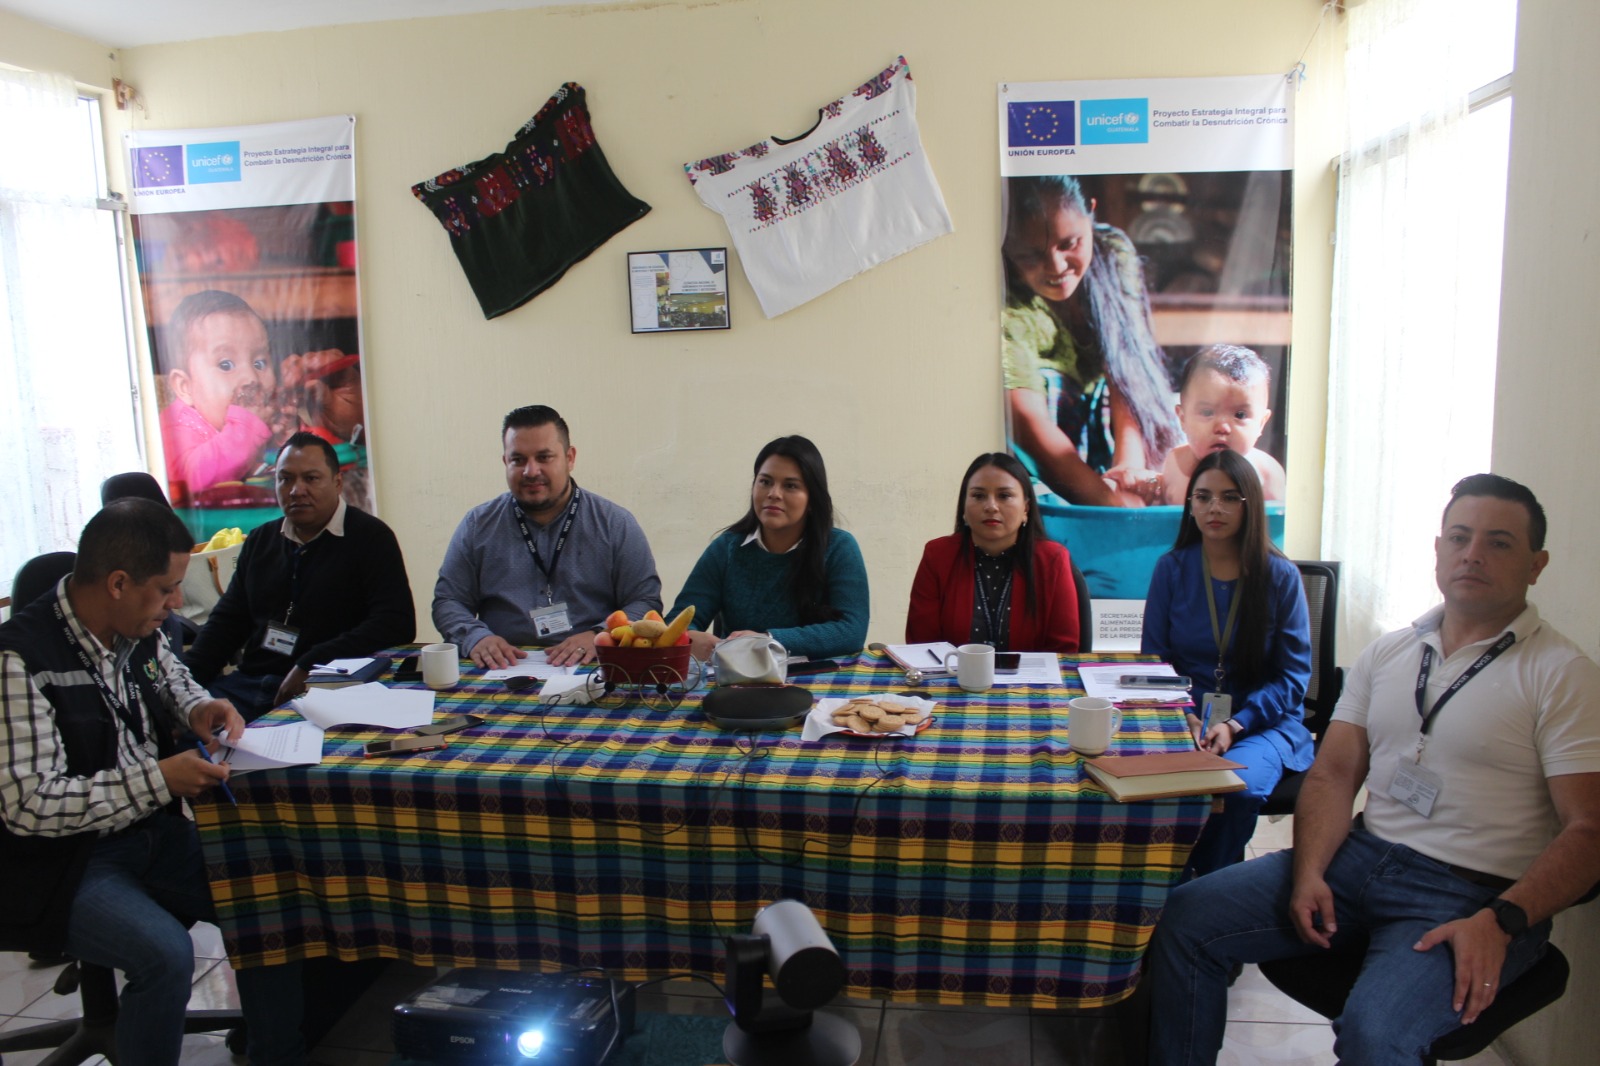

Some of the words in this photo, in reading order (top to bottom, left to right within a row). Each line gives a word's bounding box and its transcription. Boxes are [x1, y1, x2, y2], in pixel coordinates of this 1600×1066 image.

[1087, 112, 1124, 126] unicef
[1153, 109, 1190, 118] Proyecto
[1191, 108, 1233, 117] Estrategia
[1235, 107, 1266, 116] Integral
[1268, 107, 1286, 115] para
[1153, 119, 1190, 127] Combatir
[1202, 117, 1254, 126] Desnutrición
[1256, 117, 1288, 125] Crónica
[243, 150, 273, 158] Proyecto
[274, 147, 307, 156] Estrategia
[308, 145, 333, 154] Integral
[1008, 149, 1035, 157] UNIÓN
[192, 155, 222, 168] unicef
[244, 158, 274, 166] Combatir
[282, 155, 324, 164] Desnutrición
[1474, 655, 1492, 669] SESAN
[1452, 675, 1469, 690] SESAN
[128, 682, 136, 699] SESAN
[450, 1035, 475, 1044] EPSON
